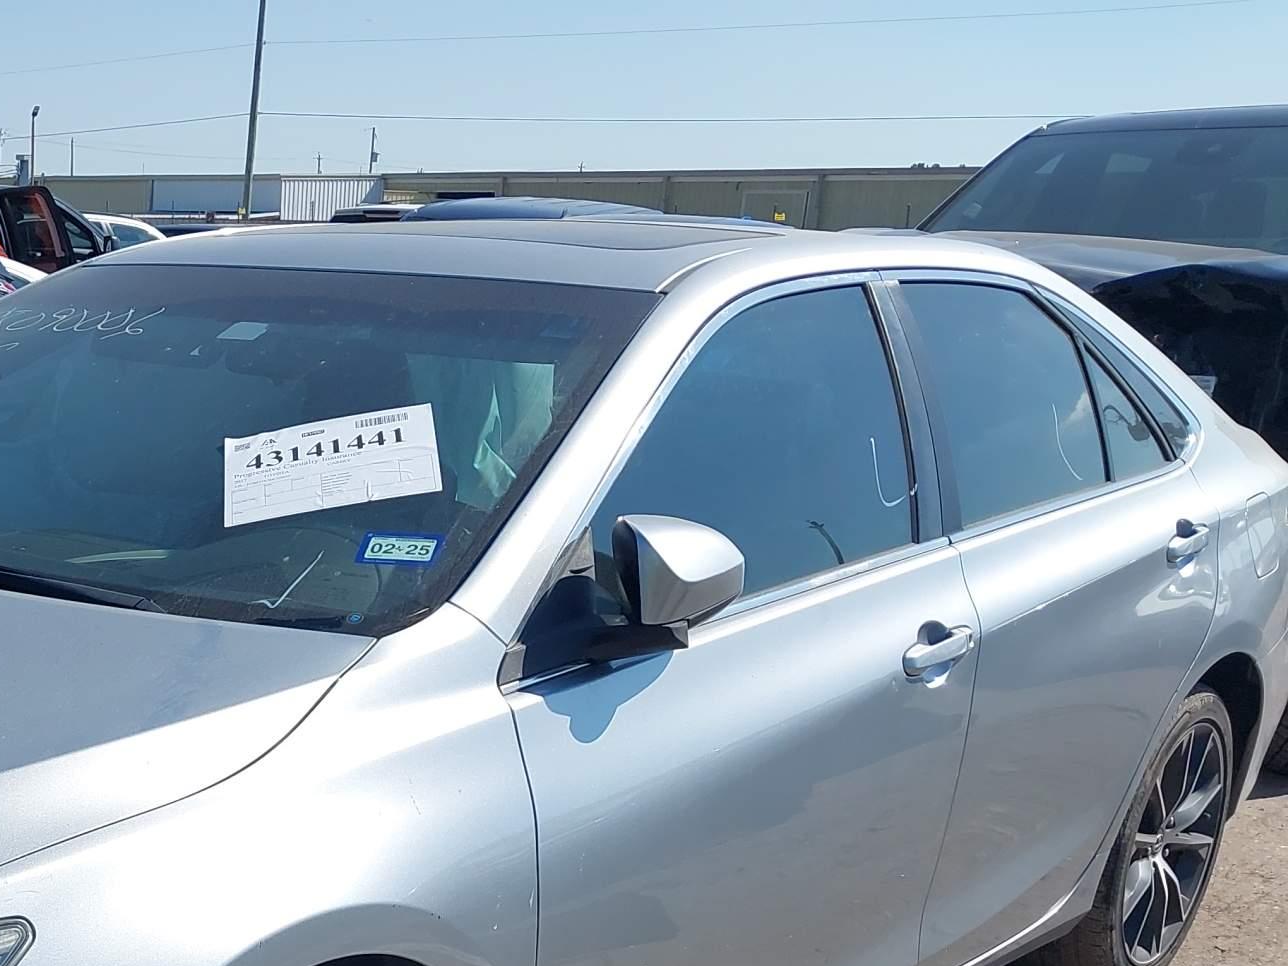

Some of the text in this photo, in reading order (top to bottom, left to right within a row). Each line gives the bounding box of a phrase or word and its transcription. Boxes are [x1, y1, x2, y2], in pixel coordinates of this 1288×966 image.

[245, 427, 408, 470] 43141441
[233, 451, 362, 480] Progressive Casualty Insurance
[370, 543, 432, 556] 02 25
